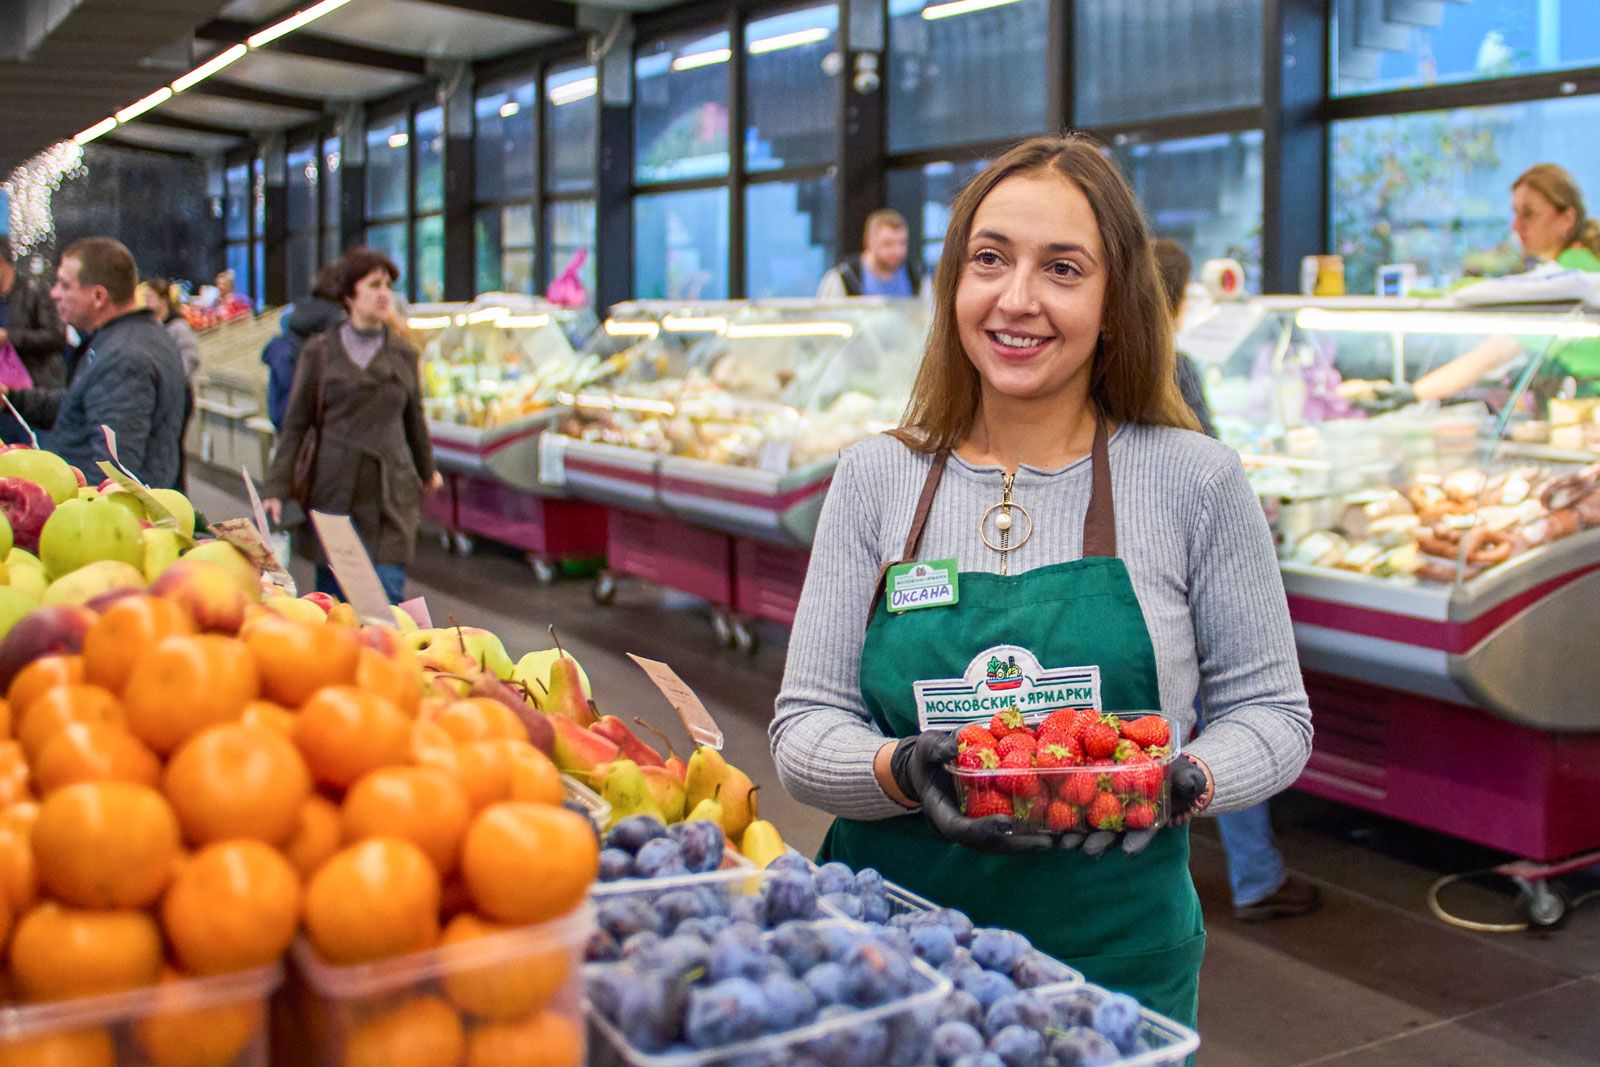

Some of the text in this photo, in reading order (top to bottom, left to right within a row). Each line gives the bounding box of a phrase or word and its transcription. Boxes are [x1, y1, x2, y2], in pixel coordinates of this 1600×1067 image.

[892, 585, 950, 606] ОКСАНА
[925, 687, 1093, 713] МОСКОВСКИЕ ЯРМАРКИ
